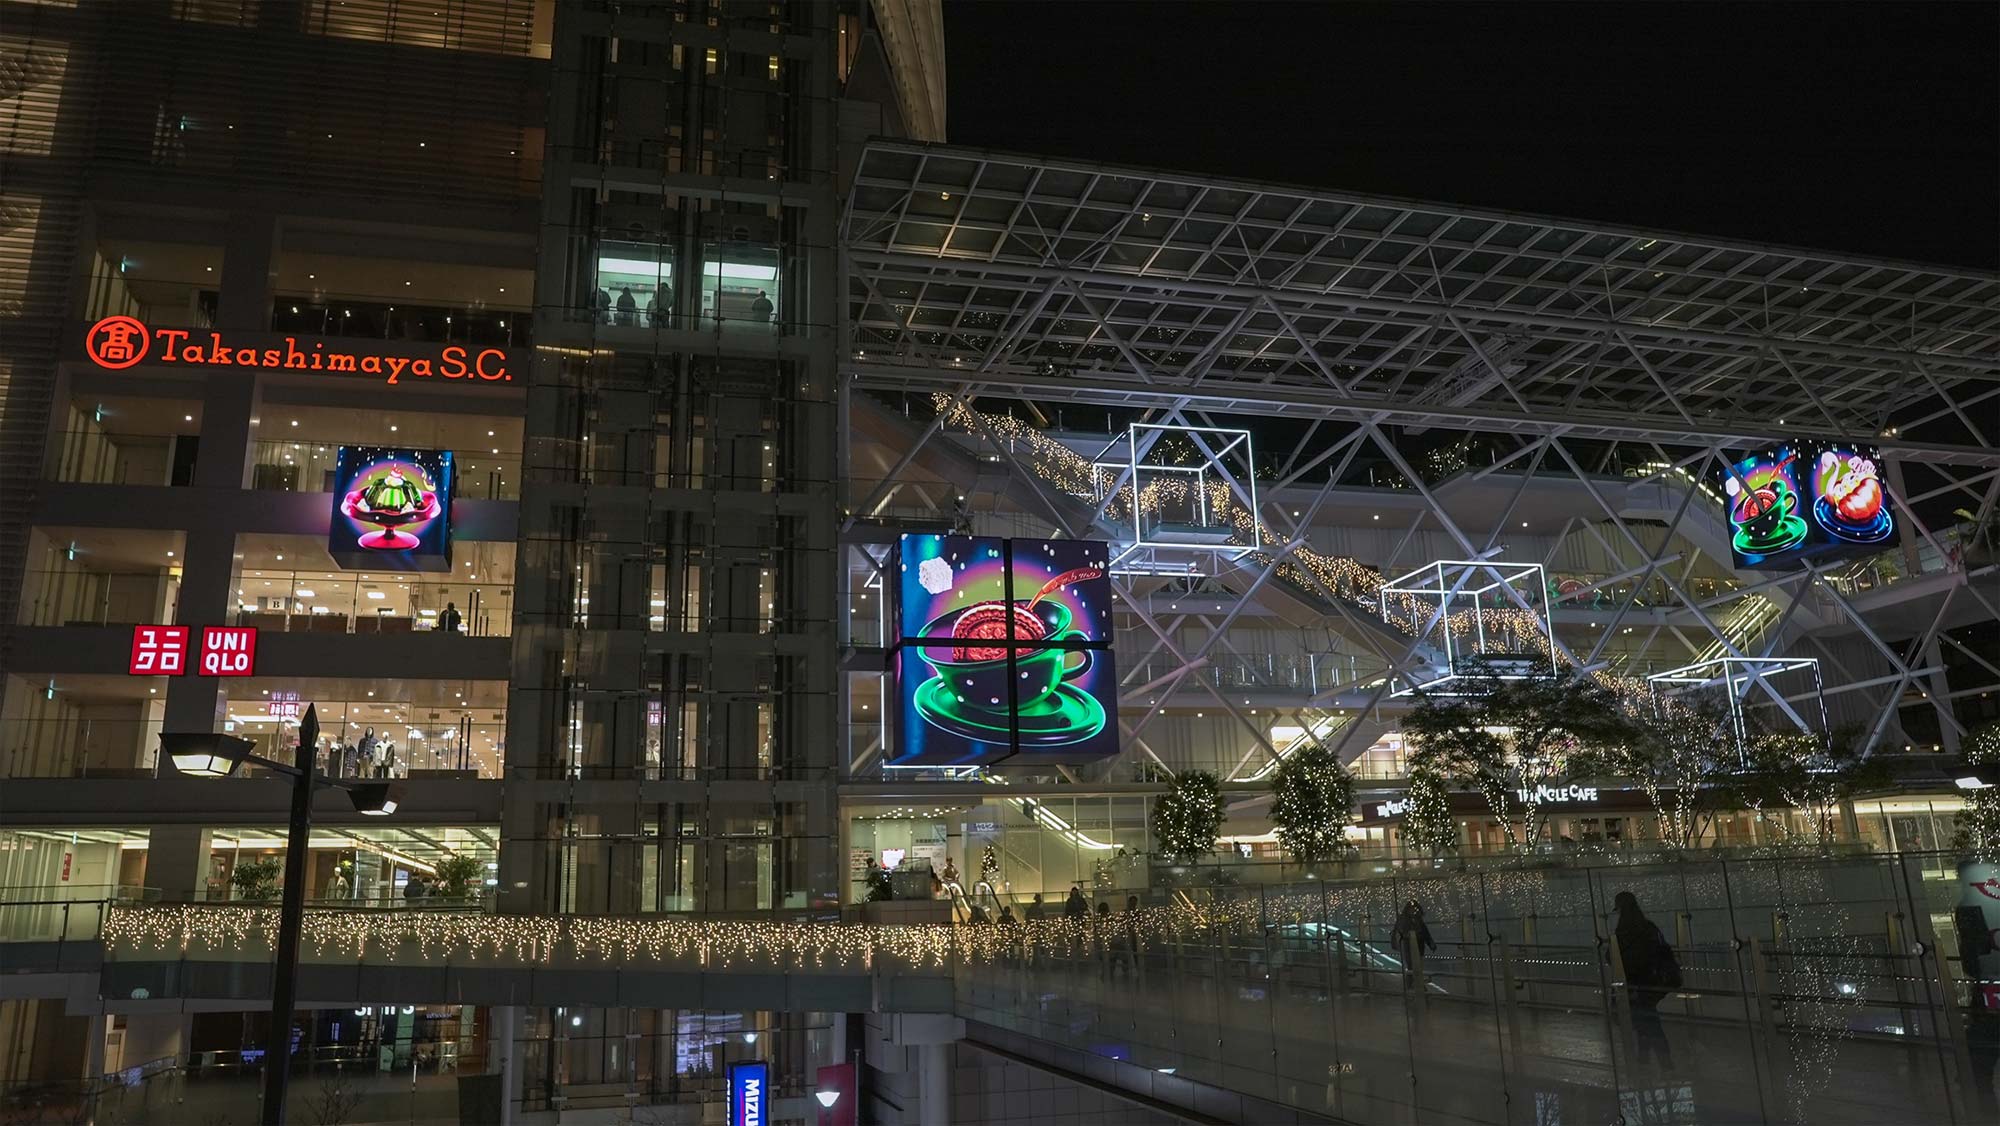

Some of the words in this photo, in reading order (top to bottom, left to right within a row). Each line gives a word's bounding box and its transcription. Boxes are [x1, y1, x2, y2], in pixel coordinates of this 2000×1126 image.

[155, 329, 433, 385] Takashimaya
[440, 346, 512, 381] S.C.
[207, 632, 247, 651] UNI
[205, 652, 249, 674] QLO
[1569, 784, 1598, 802] CAFE
